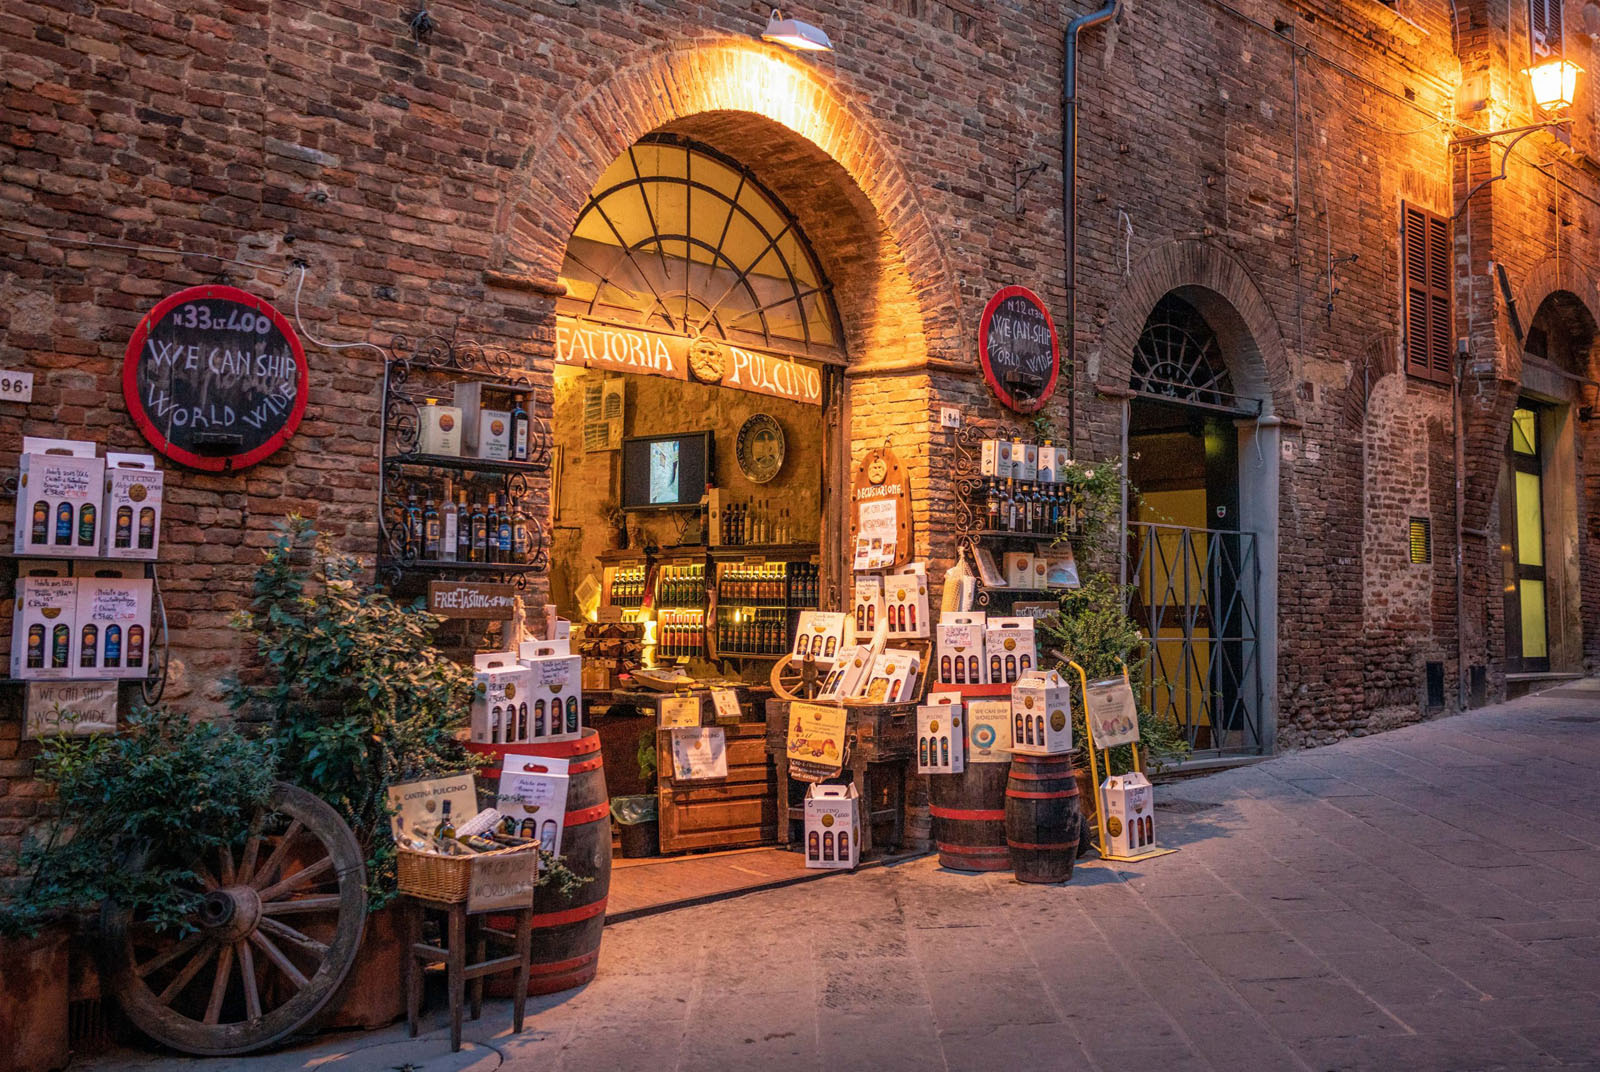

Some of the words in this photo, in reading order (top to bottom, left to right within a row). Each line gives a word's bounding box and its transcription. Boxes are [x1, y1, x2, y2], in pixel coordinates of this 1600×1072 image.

[147, 338, 200, 370] WE
[208, 347, 251, 376] CAN
[256, 354, 297, 380] SHIP
[555, 326, 673, 372] FATTORIA
[729, 346, 821, 400] PULCINO
[988, 334, 1020, 367] WORLD
[1026, 350, 1053, 373] WIDE
[148, 382, 236, 428] WORLD
[241, 382, 297, 429] WIDE
[433, 784, 468, 795] PULCINO
